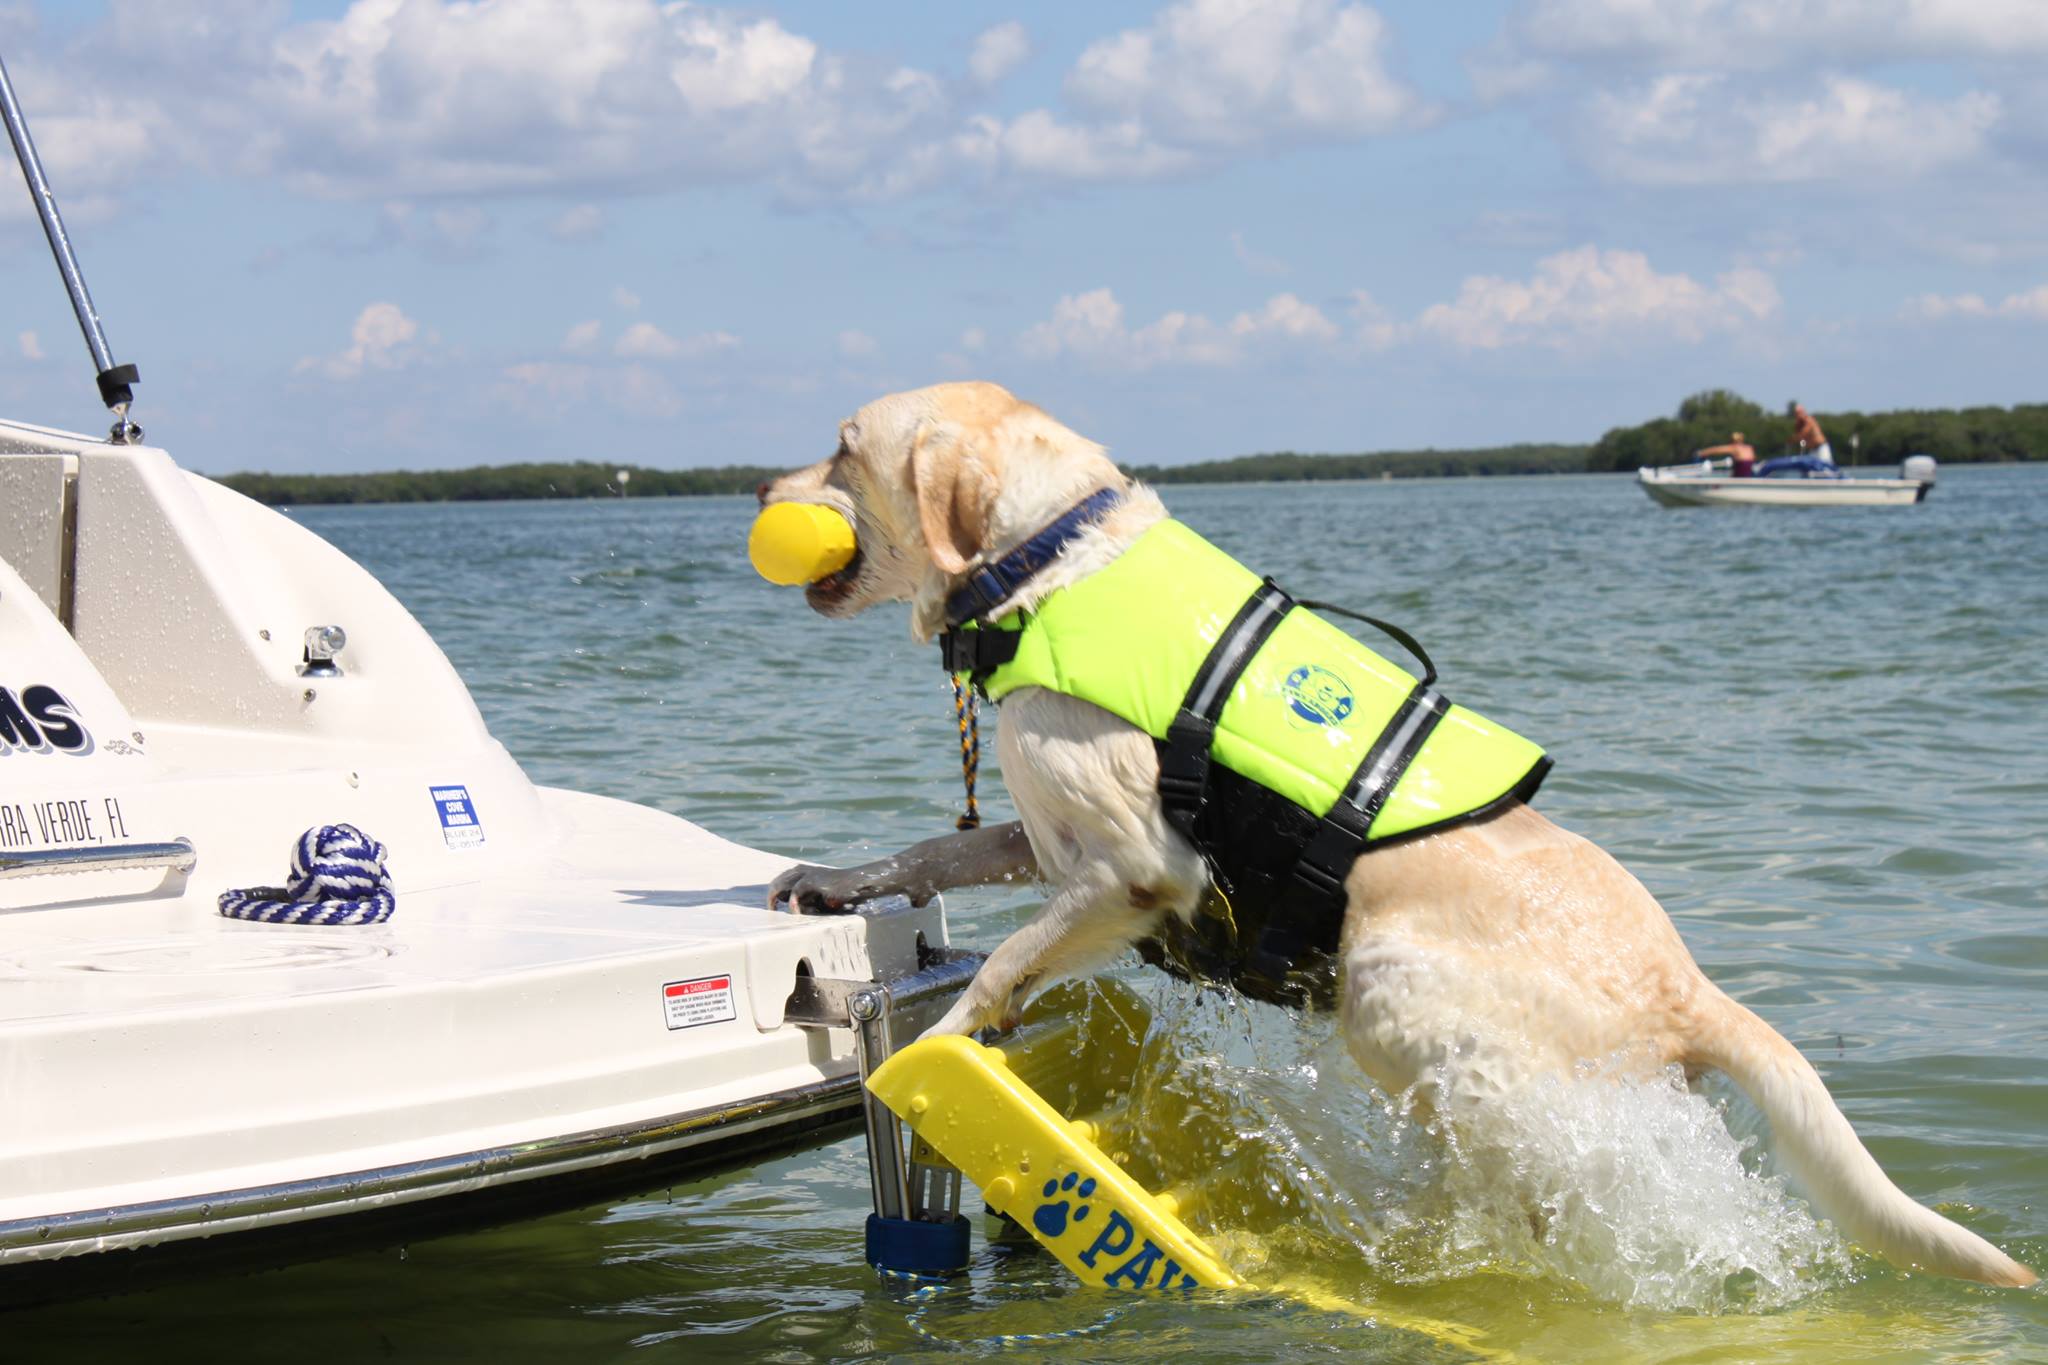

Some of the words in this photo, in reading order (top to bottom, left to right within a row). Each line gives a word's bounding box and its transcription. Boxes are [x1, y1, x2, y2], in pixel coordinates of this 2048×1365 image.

[446, 801, 465, 812] COVE
[33, 799, 103, 844] VERDE,
[105, 797, 129, 839] FL
[690, 982, 712, 993] DANGER
